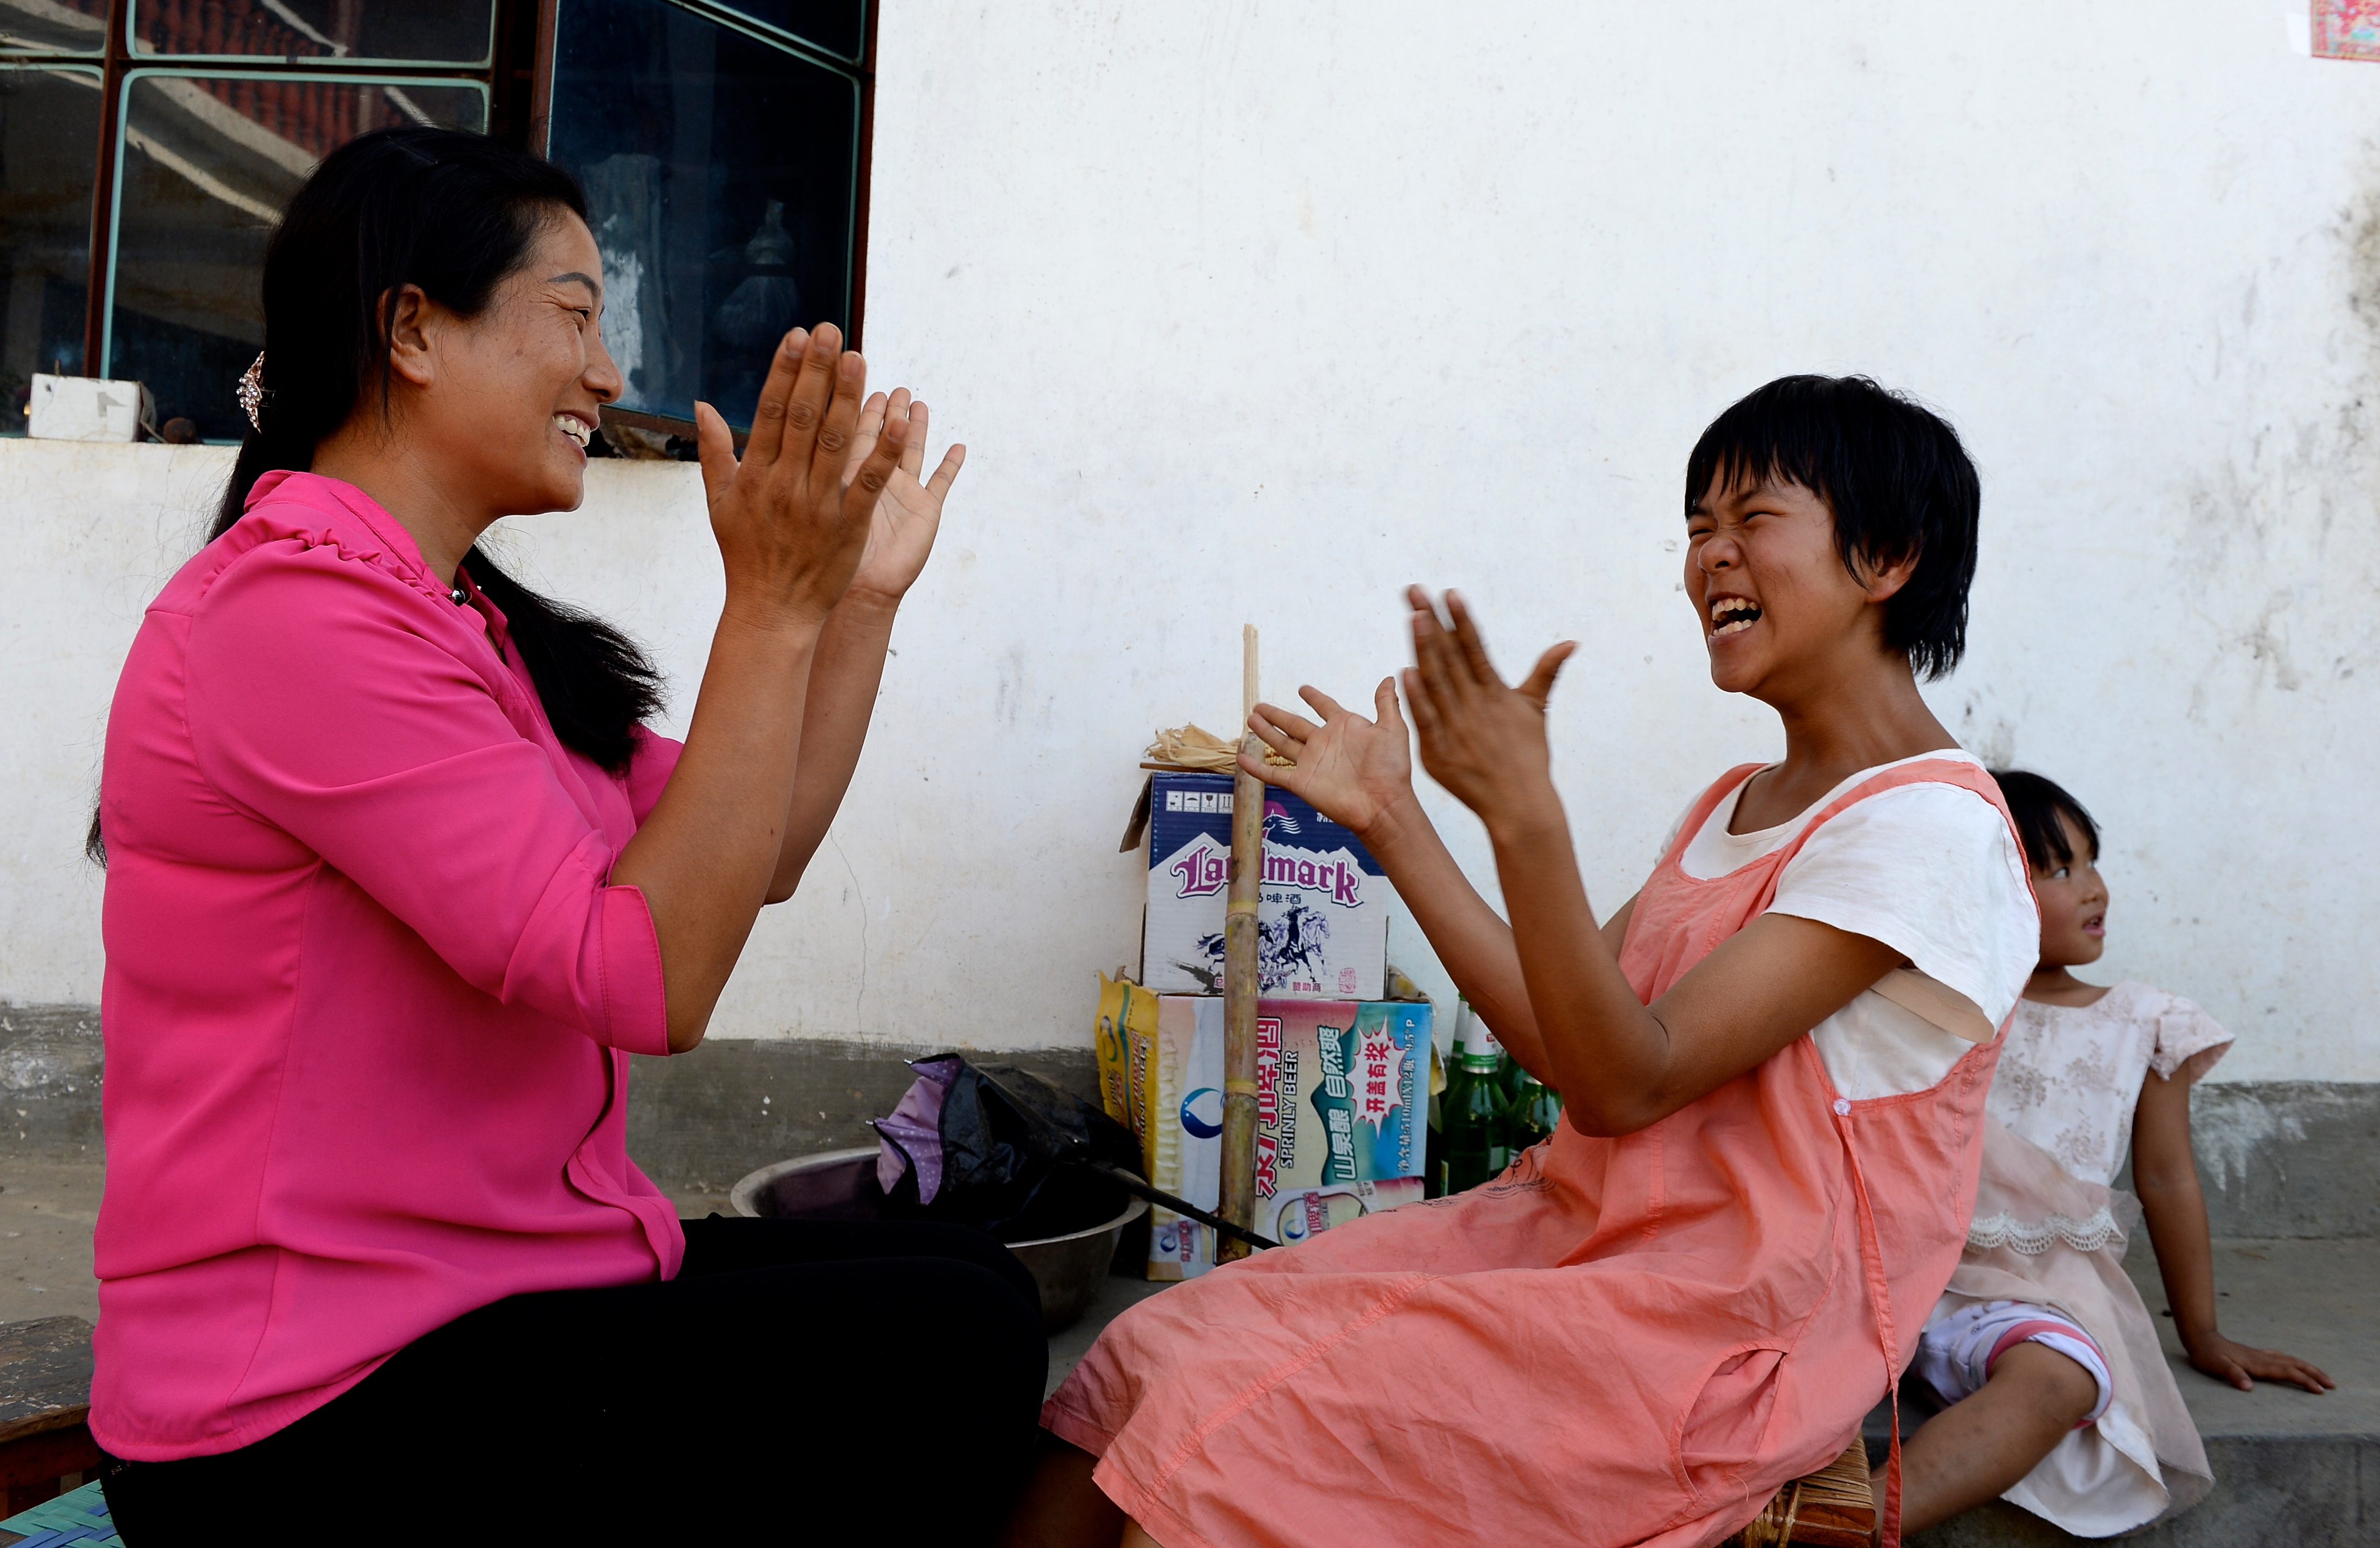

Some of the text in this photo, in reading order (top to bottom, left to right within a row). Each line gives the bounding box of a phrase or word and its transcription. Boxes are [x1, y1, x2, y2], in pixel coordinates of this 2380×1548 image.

[1172, 844, 1360, 905] Lamark
[1281, 1051, 1298, 1168] SPRINLY BEER
[1318, 1026, 1356, 1180] 山泉酿 自然爽
[1364, 1042, 1390, 1113] 开盖有奖
